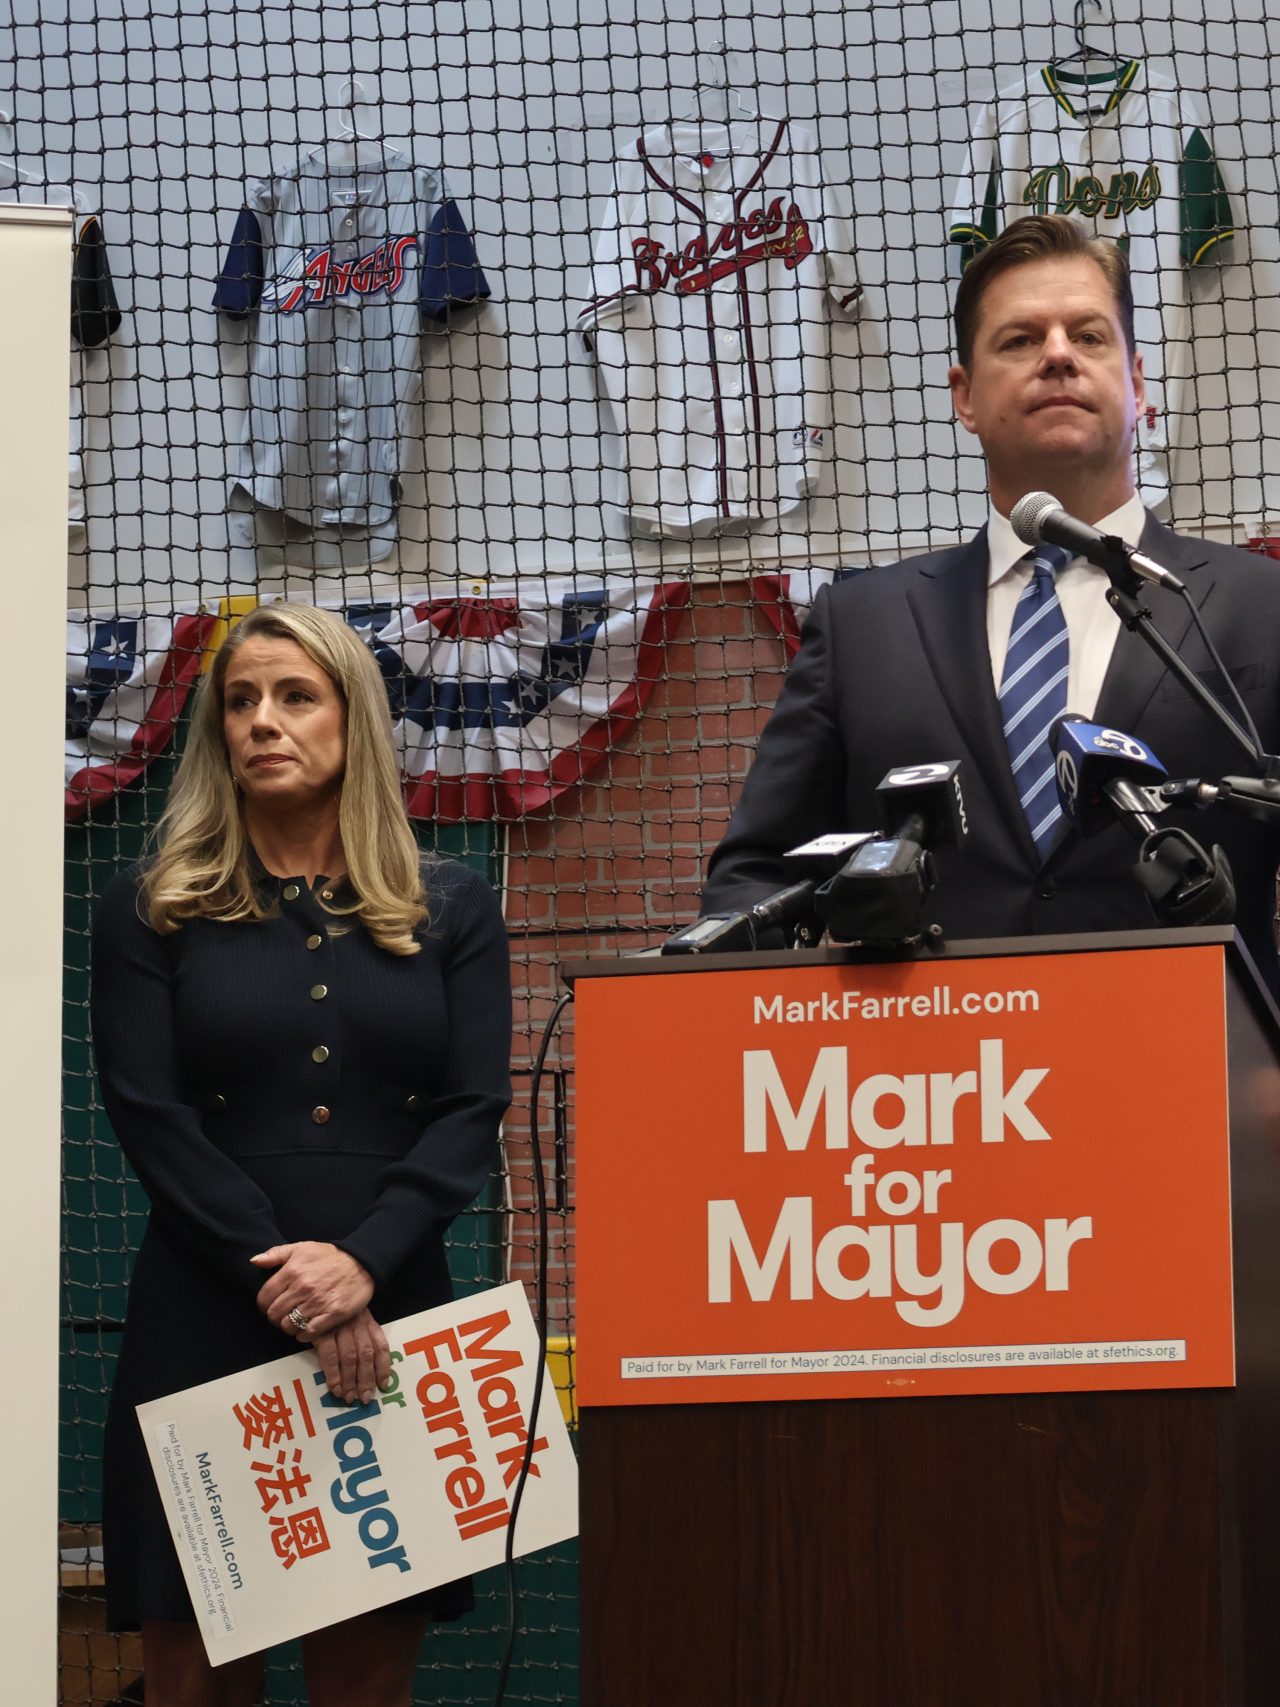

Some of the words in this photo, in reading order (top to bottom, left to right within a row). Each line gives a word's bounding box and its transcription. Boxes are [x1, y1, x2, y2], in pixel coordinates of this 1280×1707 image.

[632, 196, 786, 294] Braves
[753, 986, 1040, 1024] MarkFarrell.com
[743, 1038, 1052, 1153] Mark
[844, 1153, 952, 1217] for
[707, 1196, 1093, 1328] Mayor
[628, 1362, 654, 1373] Paid
[657, 1361, 675, 1372] for
[678, 1360, 692, 1374] by
[696, 1359, 726, 1371] Mark
[730, 1358, 767, 1370] Farrell
[770, 1357, 787, 1369] for
[792, 1357, 829, 1371] Mayor
[834, 1355, 867, 1367] 2024.
[872, 1352, 926, 1365] Financial
[930, 1352, 1001, 1364] disclosures
[1005, 1352, 1024, 1361] are
[1028, 1348, 1082, 1360] available
[1087, 1349, 1099, 1358] at
[1103, 1345, 1179, 1359] sfethics.org.
[457, 1309, 549, 1489] Mark
[165, 1423, 178, 1443] Paid
[171, 1444, 182, 1457] for
[403, 1327, 511, 1542] Farrell
[160, 1445, 183, 1497] disclosures
[172, 1458, 186, 1471] by
[179, 1471, 193, 1494] Mark
[232, 1385, 331, 1570] 麥法恩
[175, 1497, 186, 1512] are
[186, 1495, 202, 1523] Farrell
[195, 1451, 243, 1591] MarkFarrell.com
[179, 1513, 199, 1552] available
[195, 1523, 206, 1536] for
[191, 1553, 201, 1563] at
[195, 1537, 214, 1566] Mayor
[214, 1593, 233, 1632] Financial
